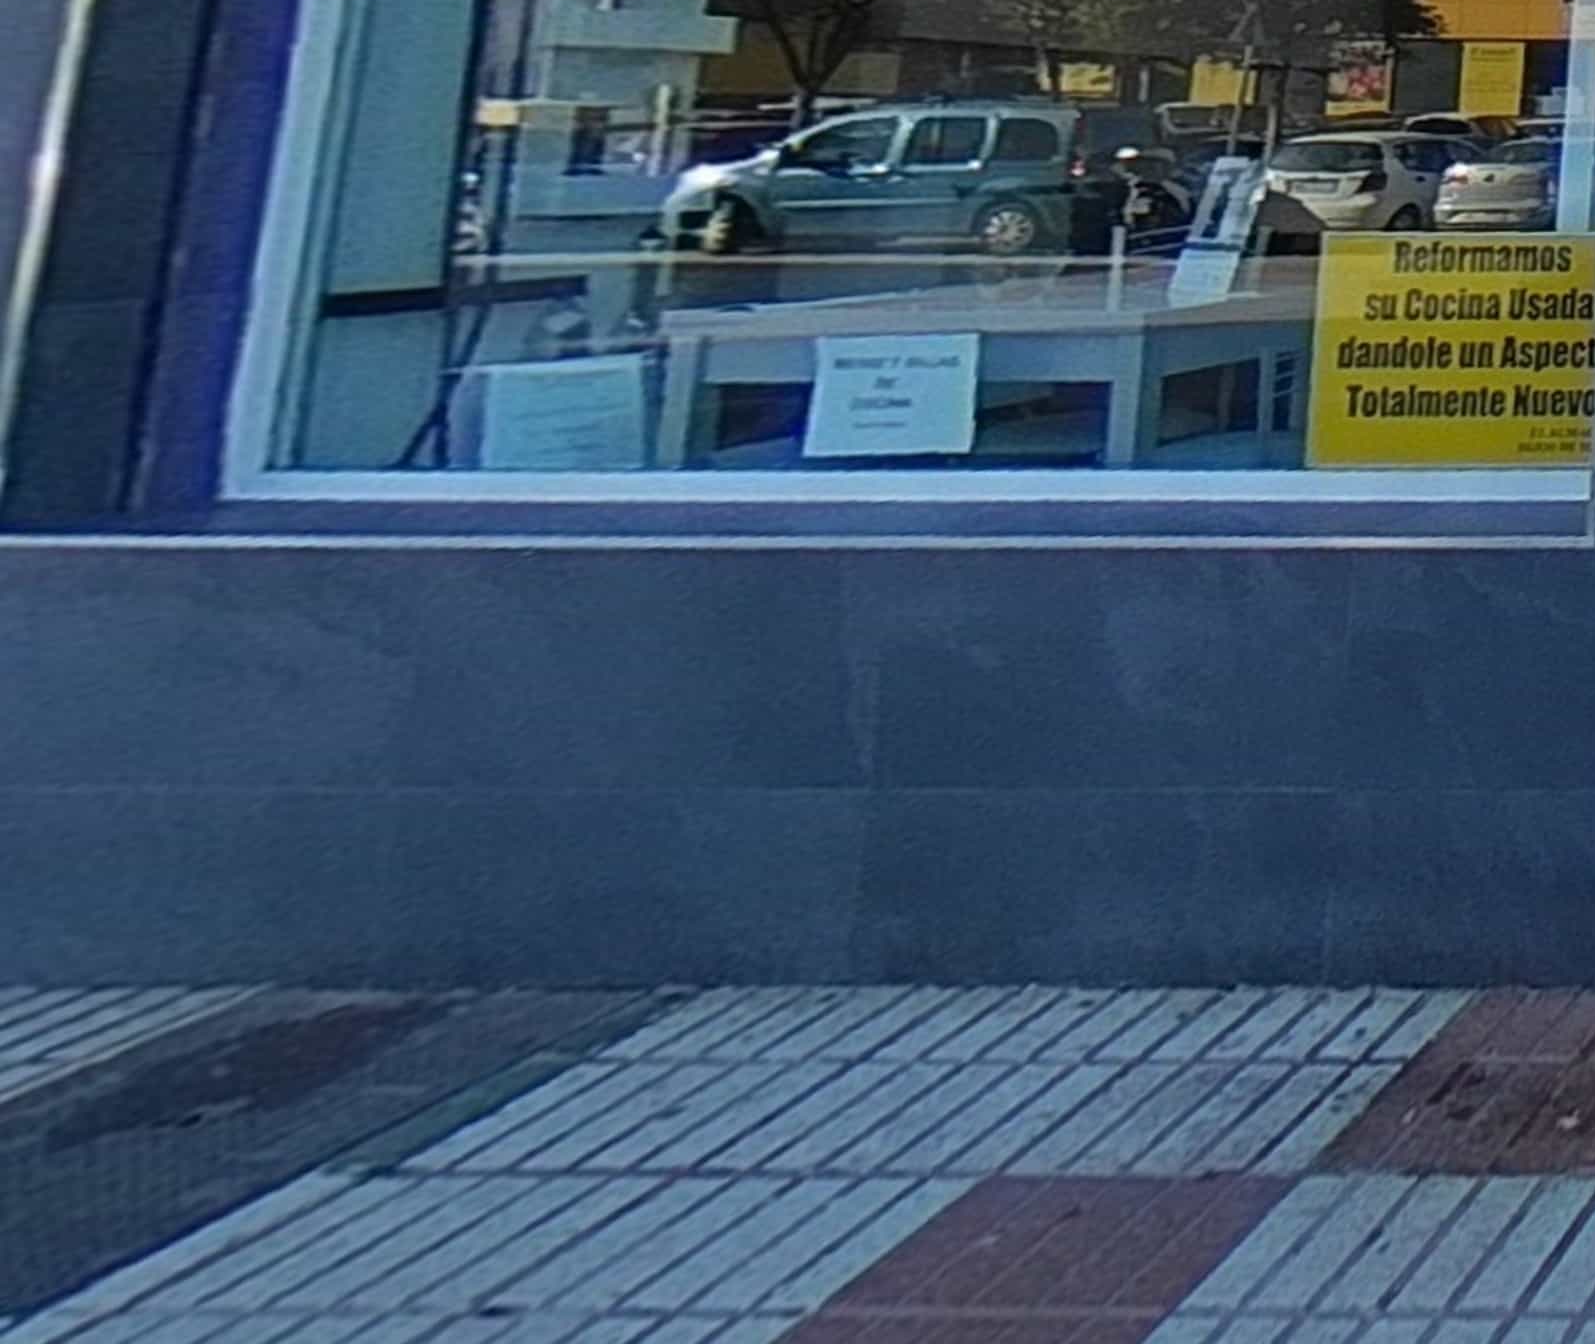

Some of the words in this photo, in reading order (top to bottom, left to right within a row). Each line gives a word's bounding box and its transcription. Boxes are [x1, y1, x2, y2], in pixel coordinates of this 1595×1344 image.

[1393, 241, 1573, 273] Reformamos
[1364, 294, 1398, 321] su
[1402, 287, 1500, 321] Cocina
[1508, 288, 1594, 321] Usada
[1337, 336, 1453, 369] dandole
[1459, 343, 1493, 369] un
[1346, 385, 1507, 417] Totalmente
